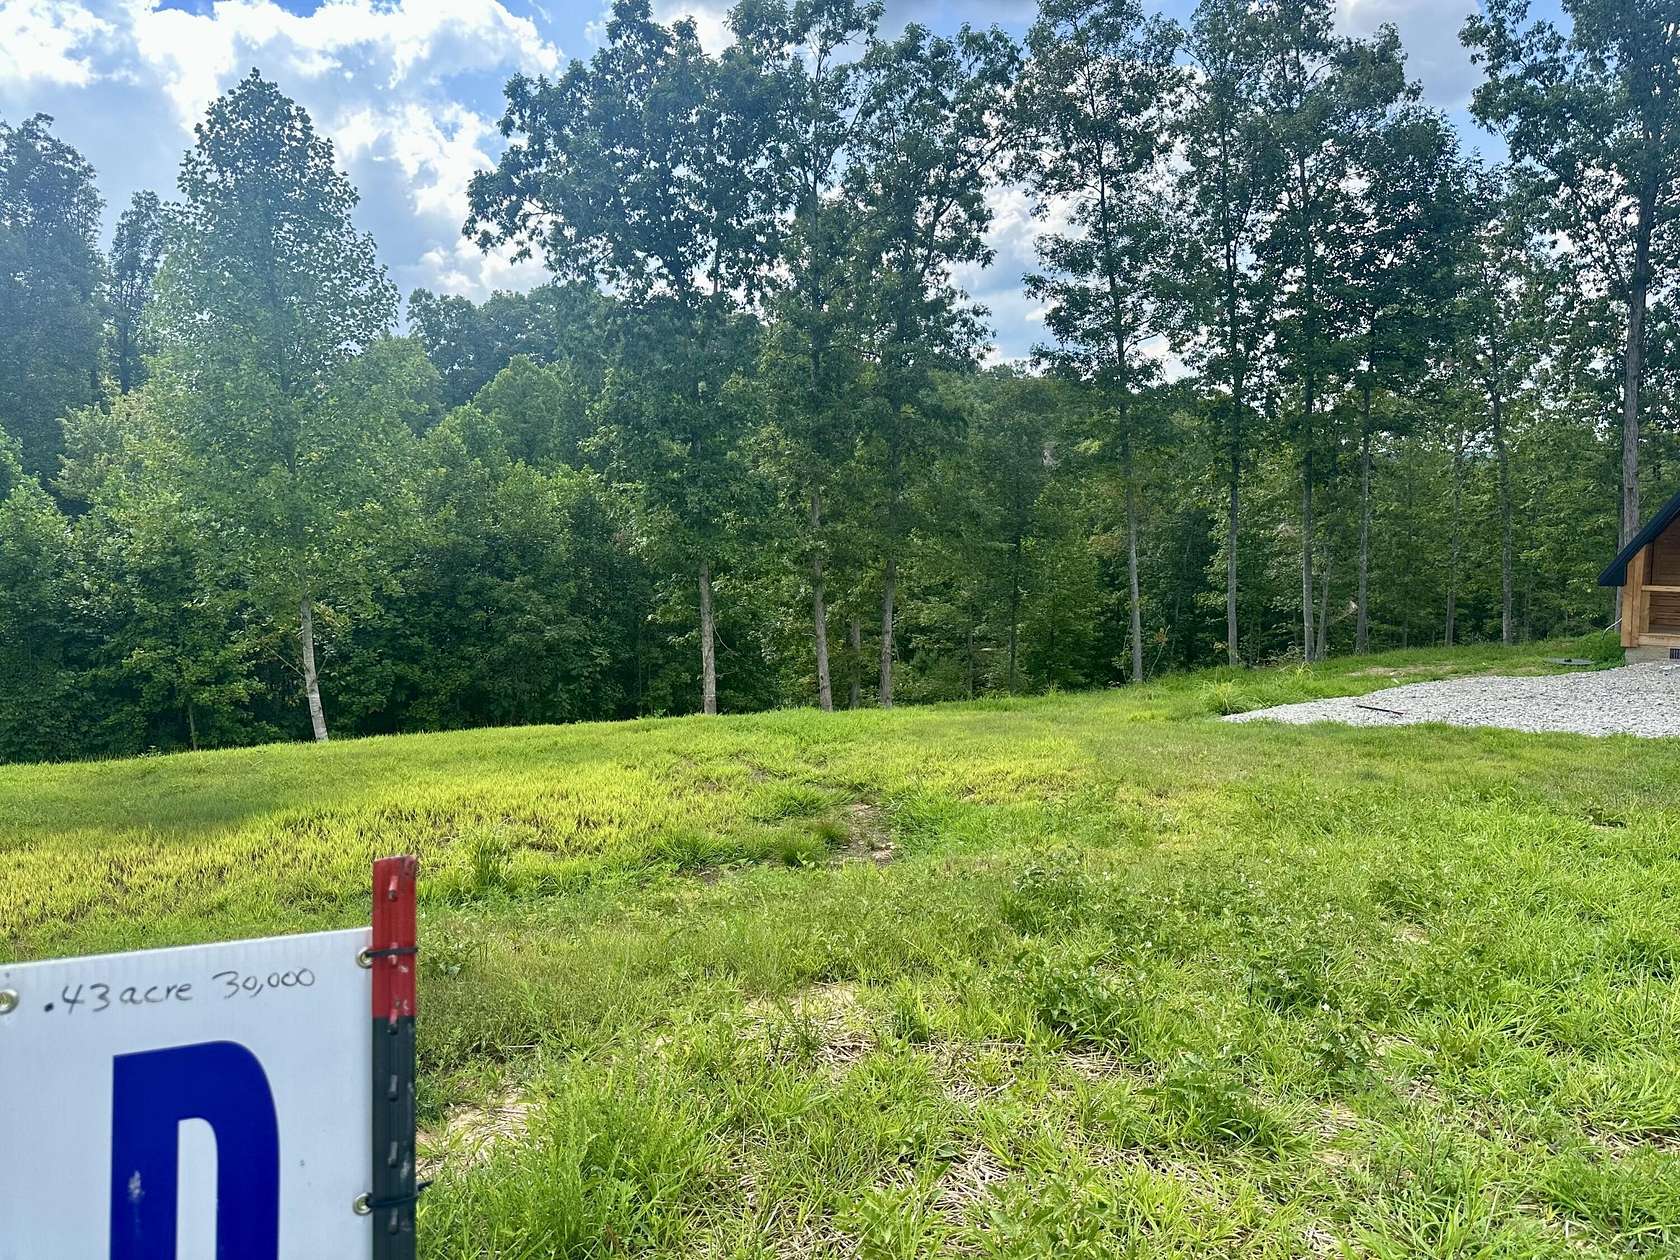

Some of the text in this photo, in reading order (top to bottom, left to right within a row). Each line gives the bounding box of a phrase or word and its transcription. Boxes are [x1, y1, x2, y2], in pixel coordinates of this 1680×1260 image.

[43, 968, 316, 1014] .43 acre 30,000
